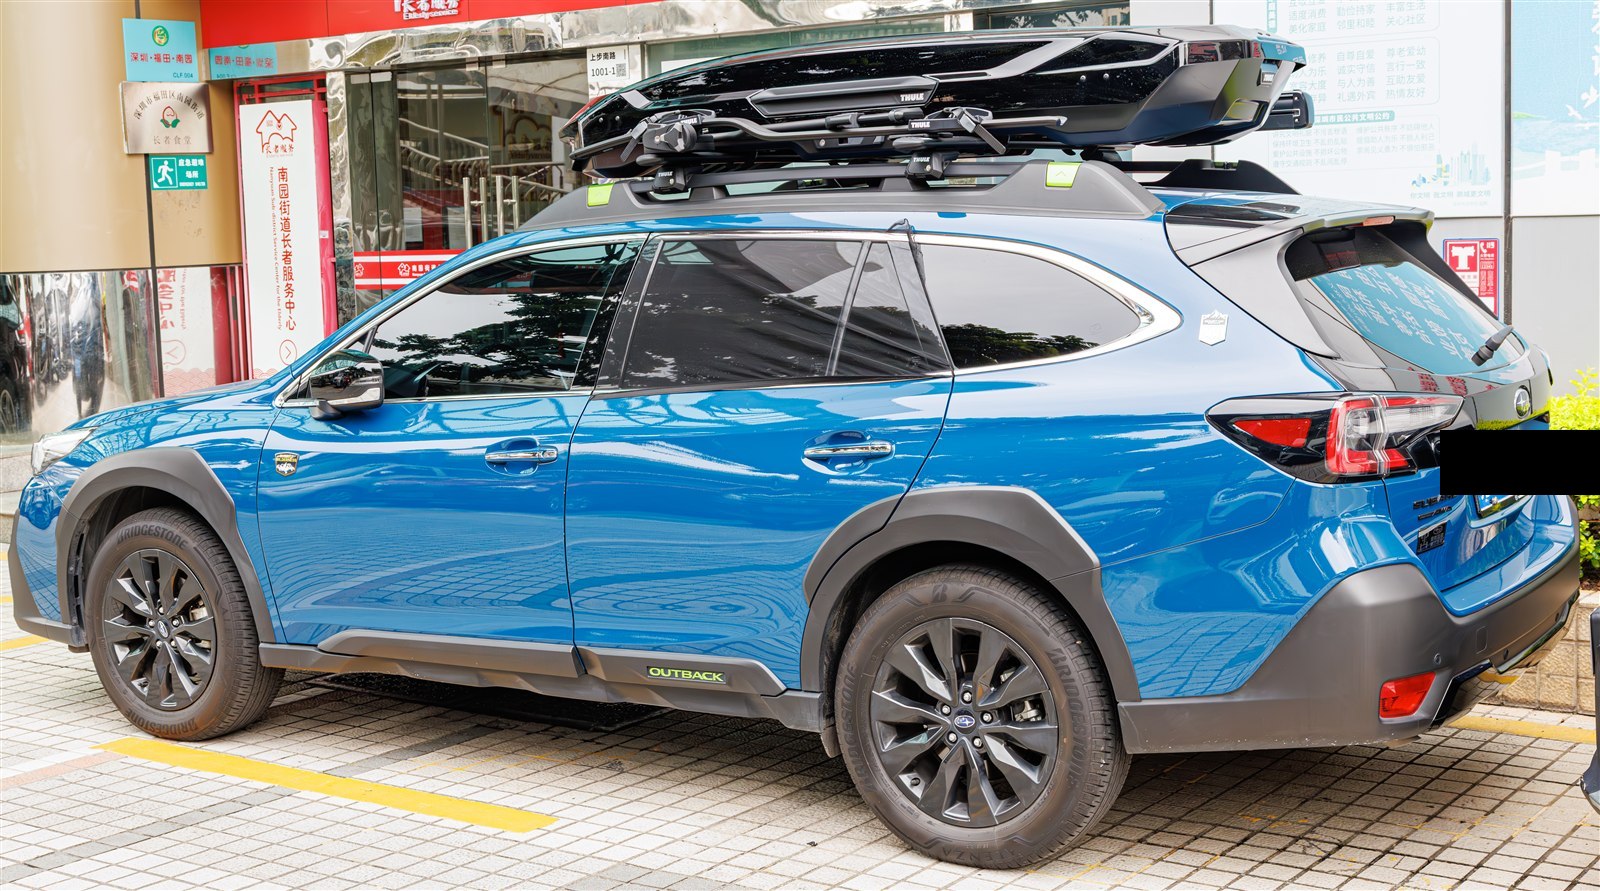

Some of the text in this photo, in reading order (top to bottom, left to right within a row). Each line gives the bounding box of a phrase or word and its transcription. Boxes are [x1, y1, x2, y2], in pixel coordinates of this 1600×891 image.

[1288, 13, 1426, 34] 美化家庭 邻里和睦 关心社区
[590, 51, 616, 61] 上步南路
[1336, 49, 1376, 61] 自尊自爱
[1385, 45, 1426, 58] 尊老爱幼
[591, 67, 616, 77] 1001-1
[1336, 63, 1376, 75] 诚实守信
[1385, 59, 1426, 72] 言行一致
[1337, 76, 1376, 89] 与人为善
[1385, 73, 1426, 87] 互助友爱
[900, 92, 924, 101] THULE
[1337, 90, 1376, 103] 礼遇外宾
[1385, 86, 1426, 99] 热情友好
[277, 166, 297, 331] 南园街道长者服务中心
[116, 524, 189, 549] BRIDGESTONE
[649, 667, 724, 682] OUTBACK
